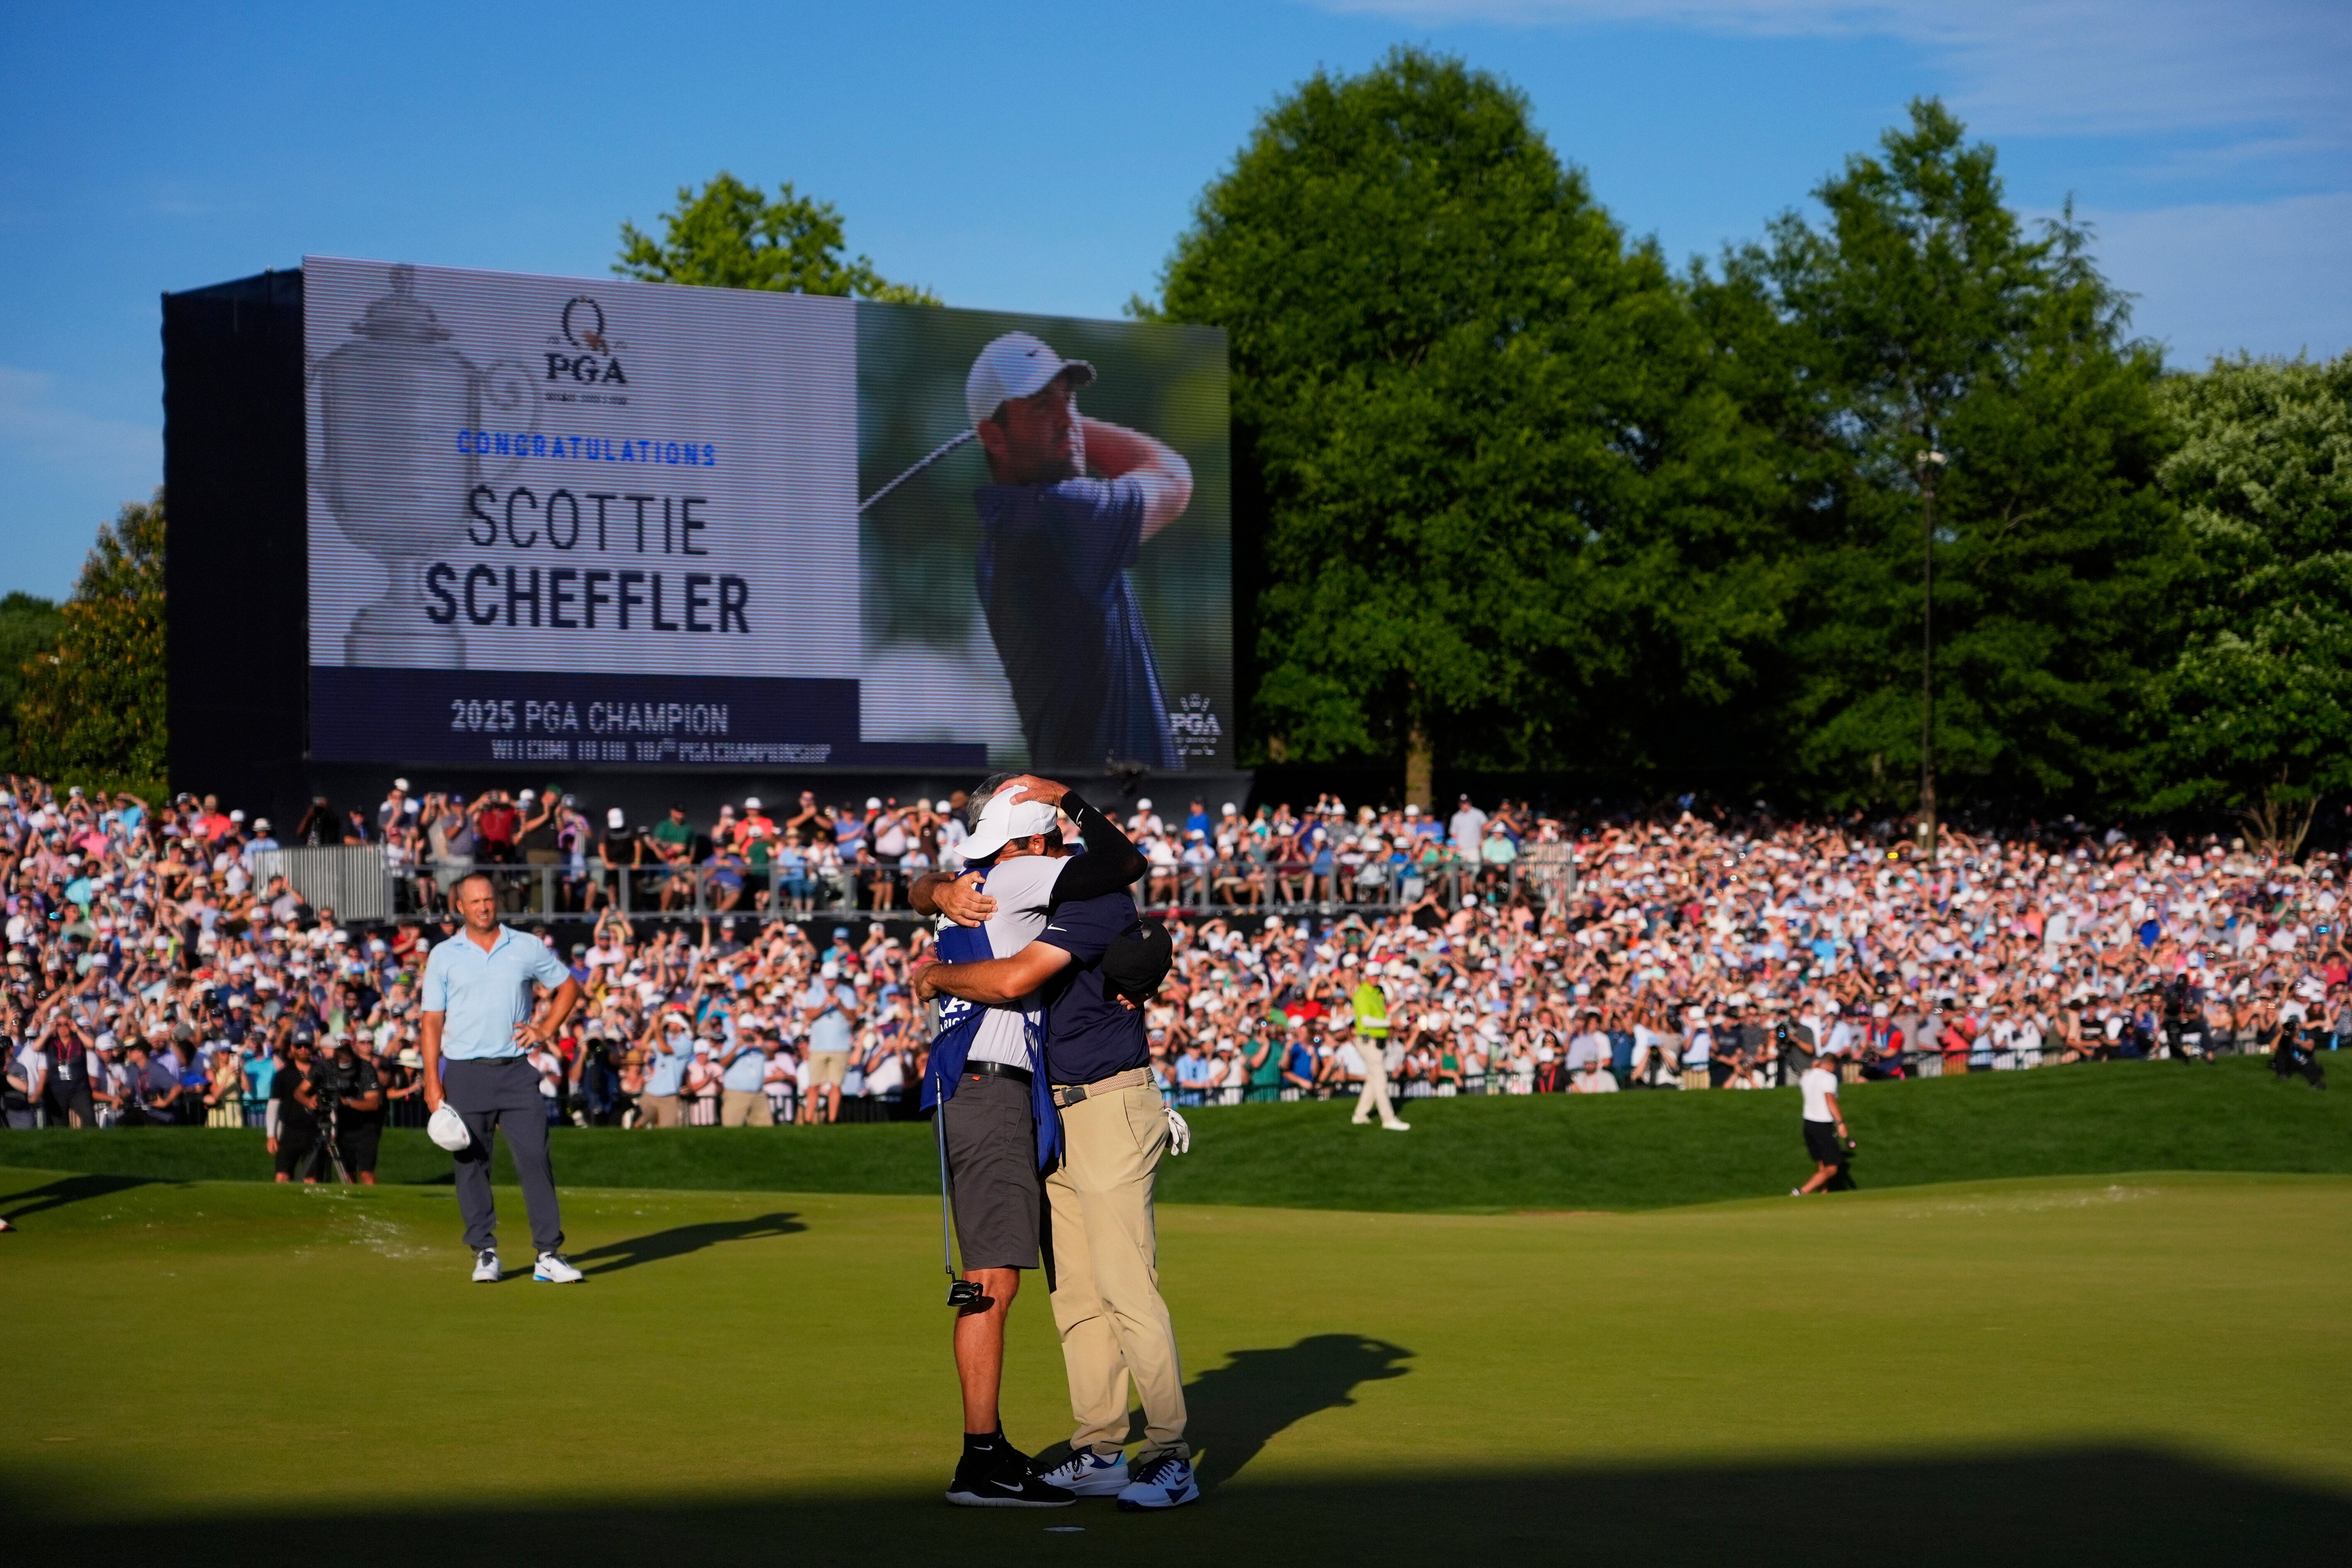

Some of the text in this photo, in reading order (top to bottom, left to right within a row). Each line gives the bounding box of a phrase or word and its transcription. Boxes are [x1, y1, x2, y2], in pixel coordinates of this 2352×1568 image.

[543, 353, 627, 385] PGA
[457, 430, 715, 466] CONGRATULATIONS
[468, 484, 708, 555] SCOTTIE
[425, 562, 749, 633] SCHEFFLER
[451, 699, 728, 734] 2025 PGA CHAMPION
[1169, 713, 1222, 735] PGA
